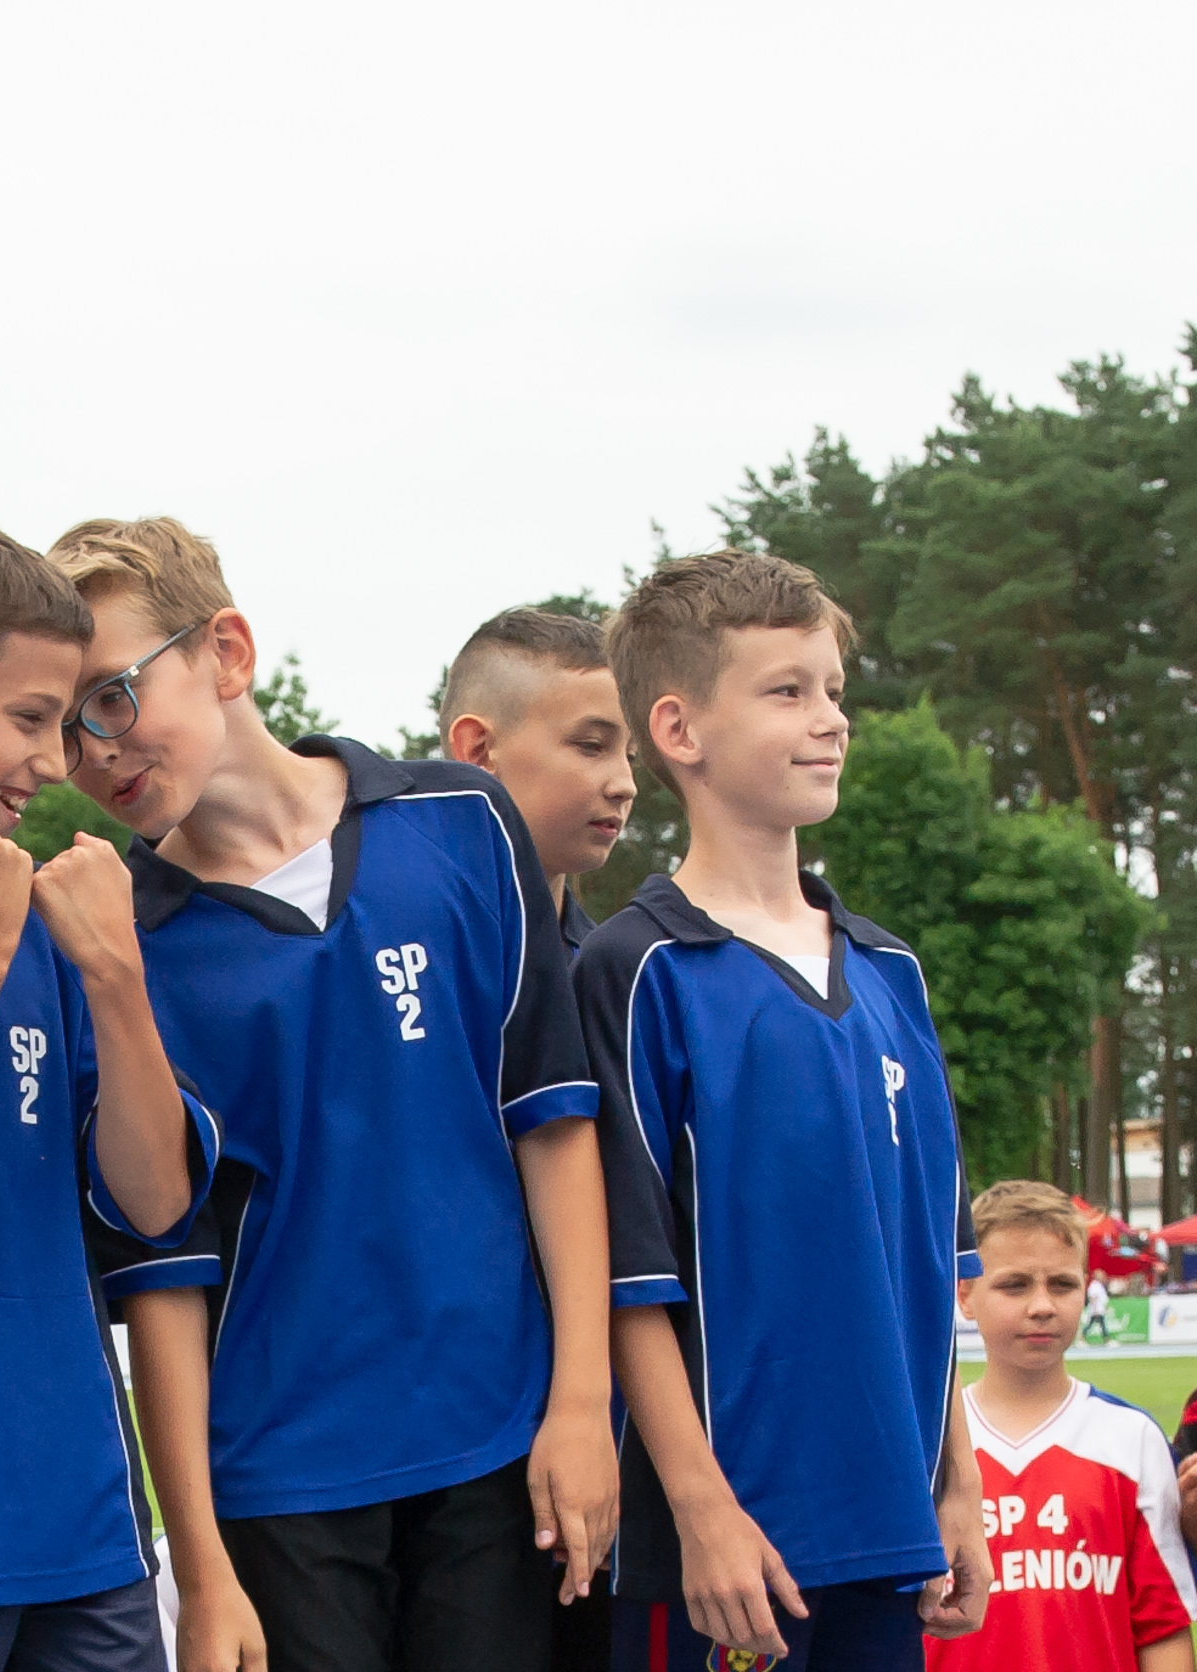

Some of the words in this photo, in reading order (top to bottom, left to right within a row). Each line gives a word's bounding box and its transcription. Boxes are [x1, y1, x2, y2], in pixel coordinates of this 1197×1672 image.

[375, 943, 428, 995] SP
[396, 993, 426, 1041] 2
[9, 1025, 47, 1075] SP
[19, 1075, 39, 1125] 2
[981, 1495, 1026, 1539] SP
[1036, 1493, 1069, 1535] 4
